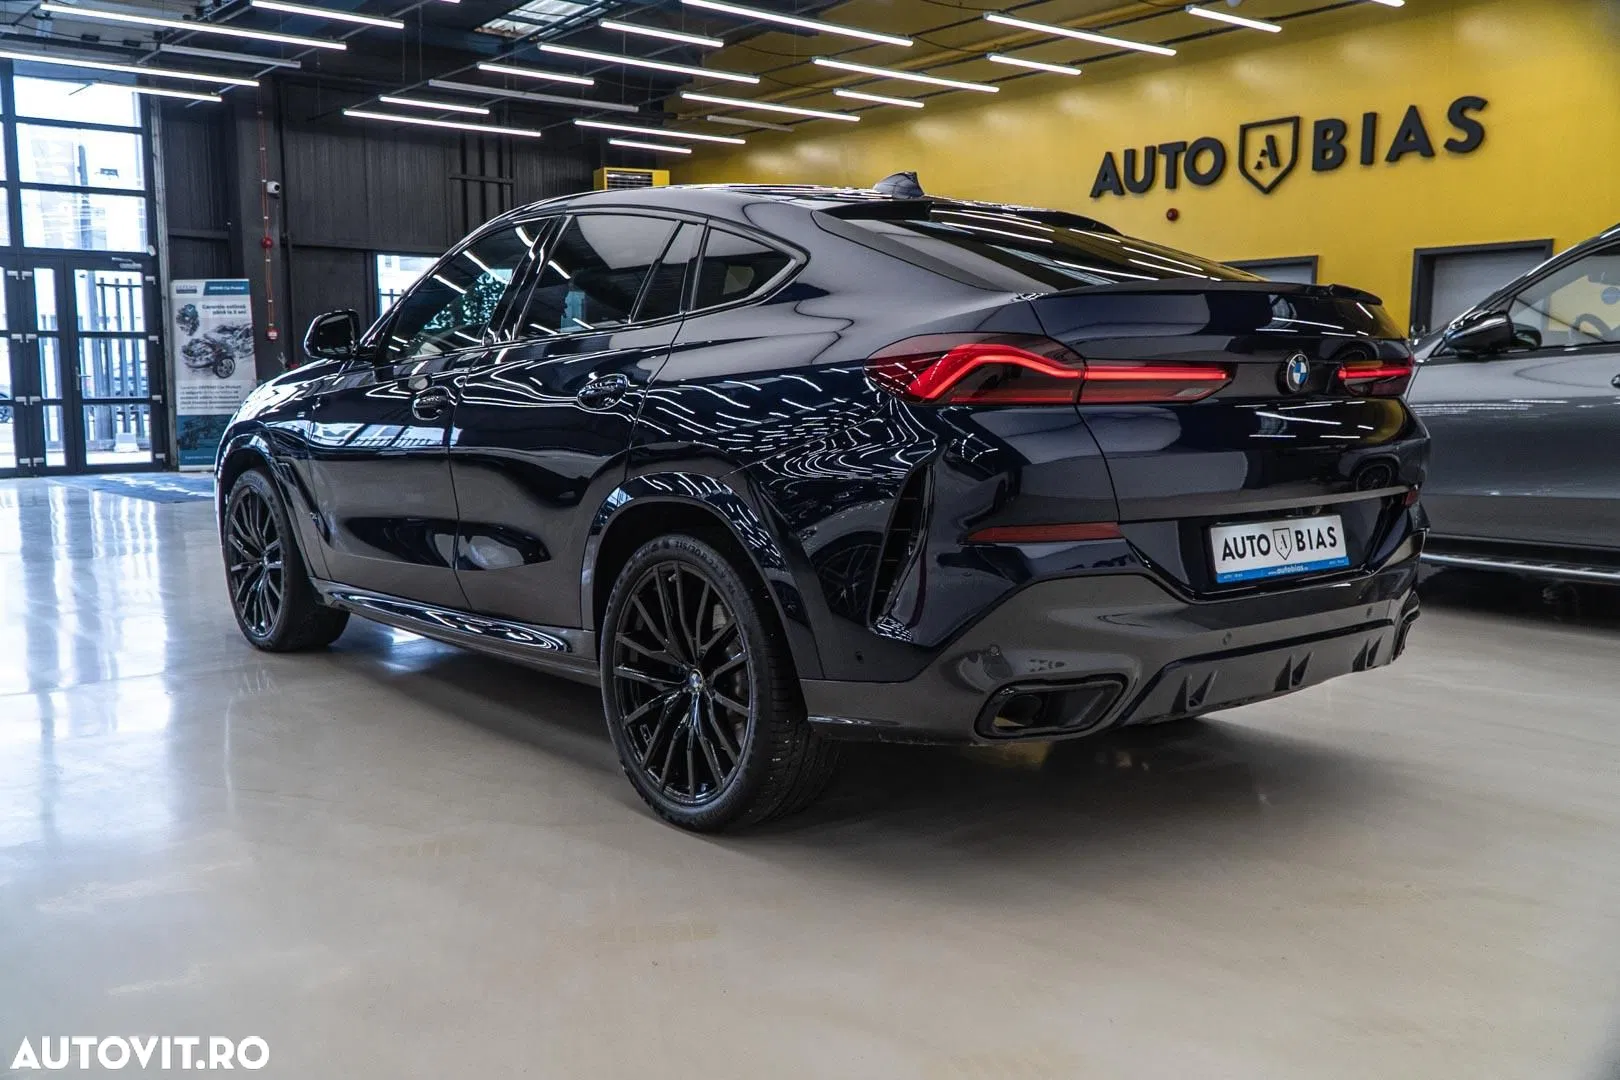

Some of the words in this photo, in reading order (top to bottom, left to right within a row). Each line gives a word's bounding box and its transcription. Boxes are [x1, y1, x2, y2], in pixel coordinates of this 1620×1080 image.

[1090, 136, 1227, 198] AUTO
[1253, 135, 1281, 170] A
[1312, 95, 1488, 172] BIAS
[1222, 534, 1271, 561] AUTO
[1295, 526, 1337, 552] BIAS
